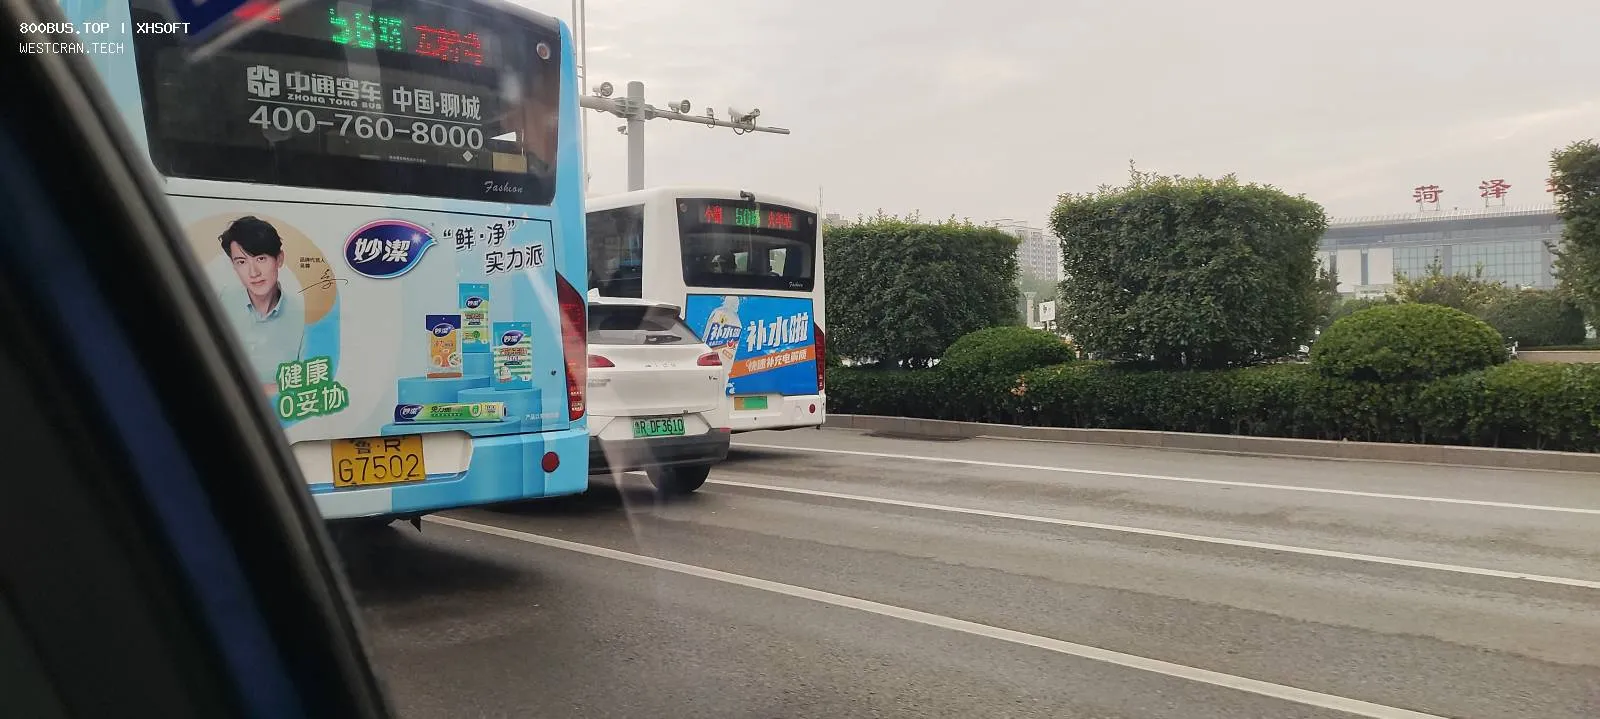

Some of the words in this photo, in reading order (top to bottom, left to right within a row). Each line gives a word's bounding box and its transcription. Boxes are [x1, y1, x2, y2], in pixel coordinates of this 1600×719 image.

[285, 71, 382, 103] 中通客车
[287, 93, 326, 104] ZHONG
[329, 97, 358, 107] TONG
[361, 101, 383, 110] BUS
[392, 85, 482, 121] 中国·聊城
[248, 104, 484, 150] 400-760-8000
[483, 180, 524, 194] Fashion
[354, 237, 412, 263] 妙潔
[484, 244, 544, 274] 实力派
[746, 312, 809, 353] 补水啦
[278, 358, 329, 391] 健康
[279, 386, 345, 418] 0妥协
[338, 453, 420, 483] G7502
